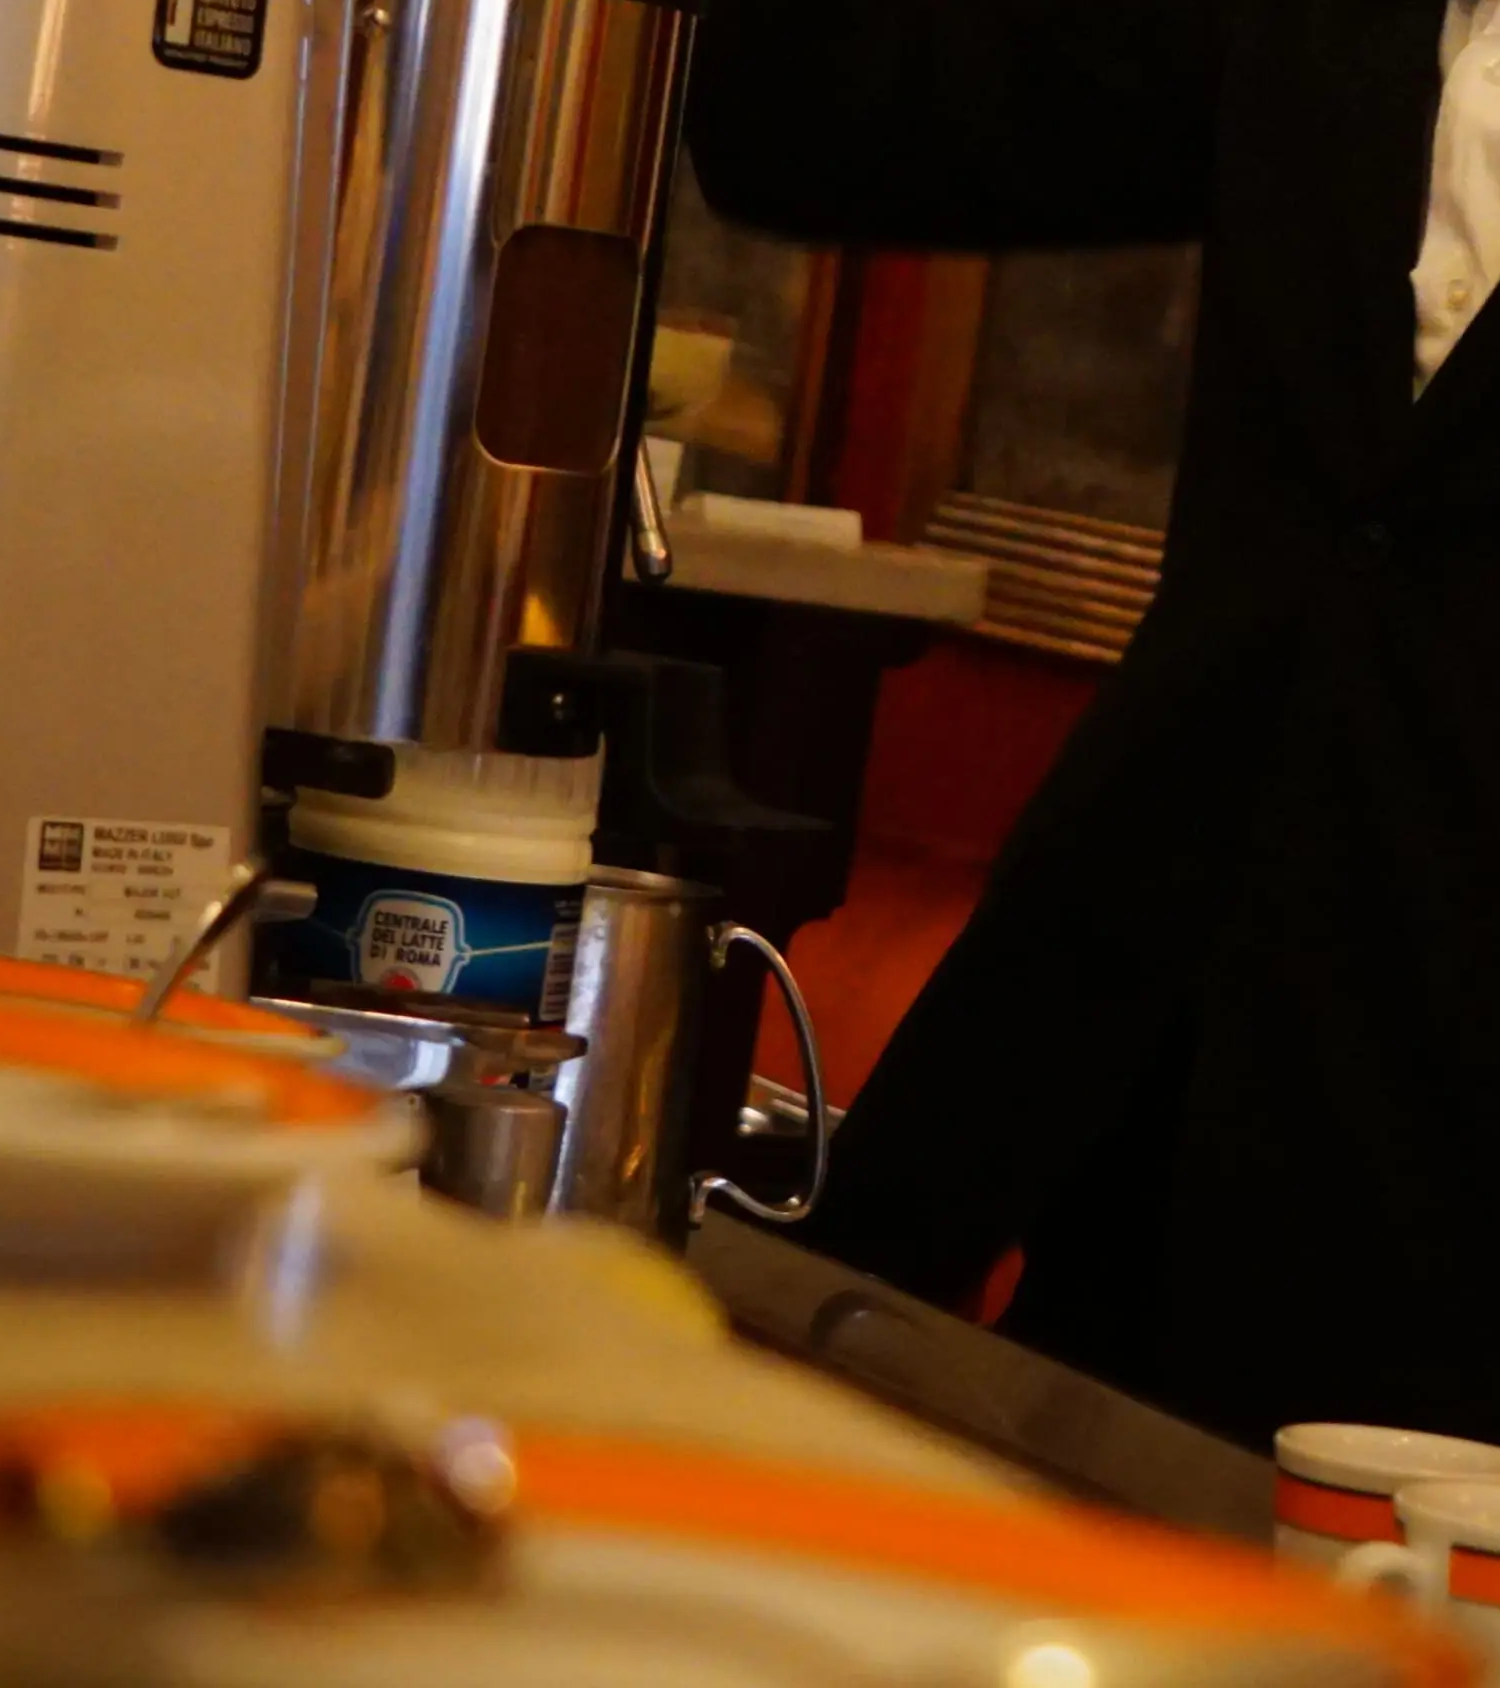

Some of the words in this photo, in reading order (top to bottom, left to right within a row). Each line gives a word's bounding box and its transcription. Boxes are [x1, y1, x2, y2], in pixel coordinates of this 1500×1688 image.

[374, 909, 450, 935] CENTRALE
[372, 927, 396, 946] DEL
[401, 930, 445, 952] LATTE
[369, 943, 387, 959] DI
[396, 947, 442, 967] ROMA
